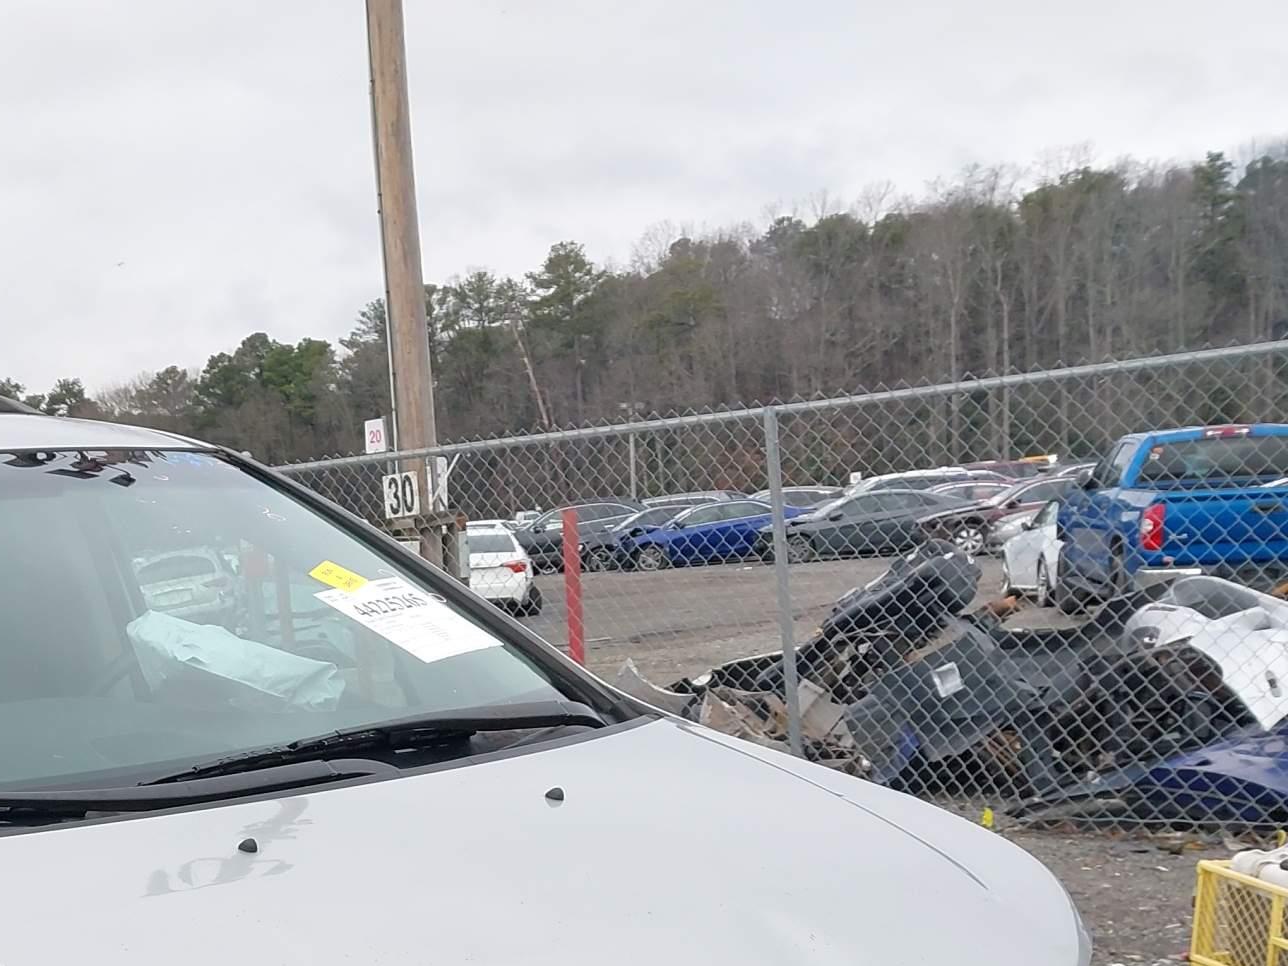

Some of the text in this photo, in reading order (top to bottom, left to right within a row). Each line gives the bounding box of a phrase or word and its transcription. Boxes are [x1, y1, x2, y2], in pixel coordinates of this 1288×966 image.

[369, 430, 382, 443] 20
[388, 474, 415, 515] 30
[353, 592, 428, 617] 44225265
